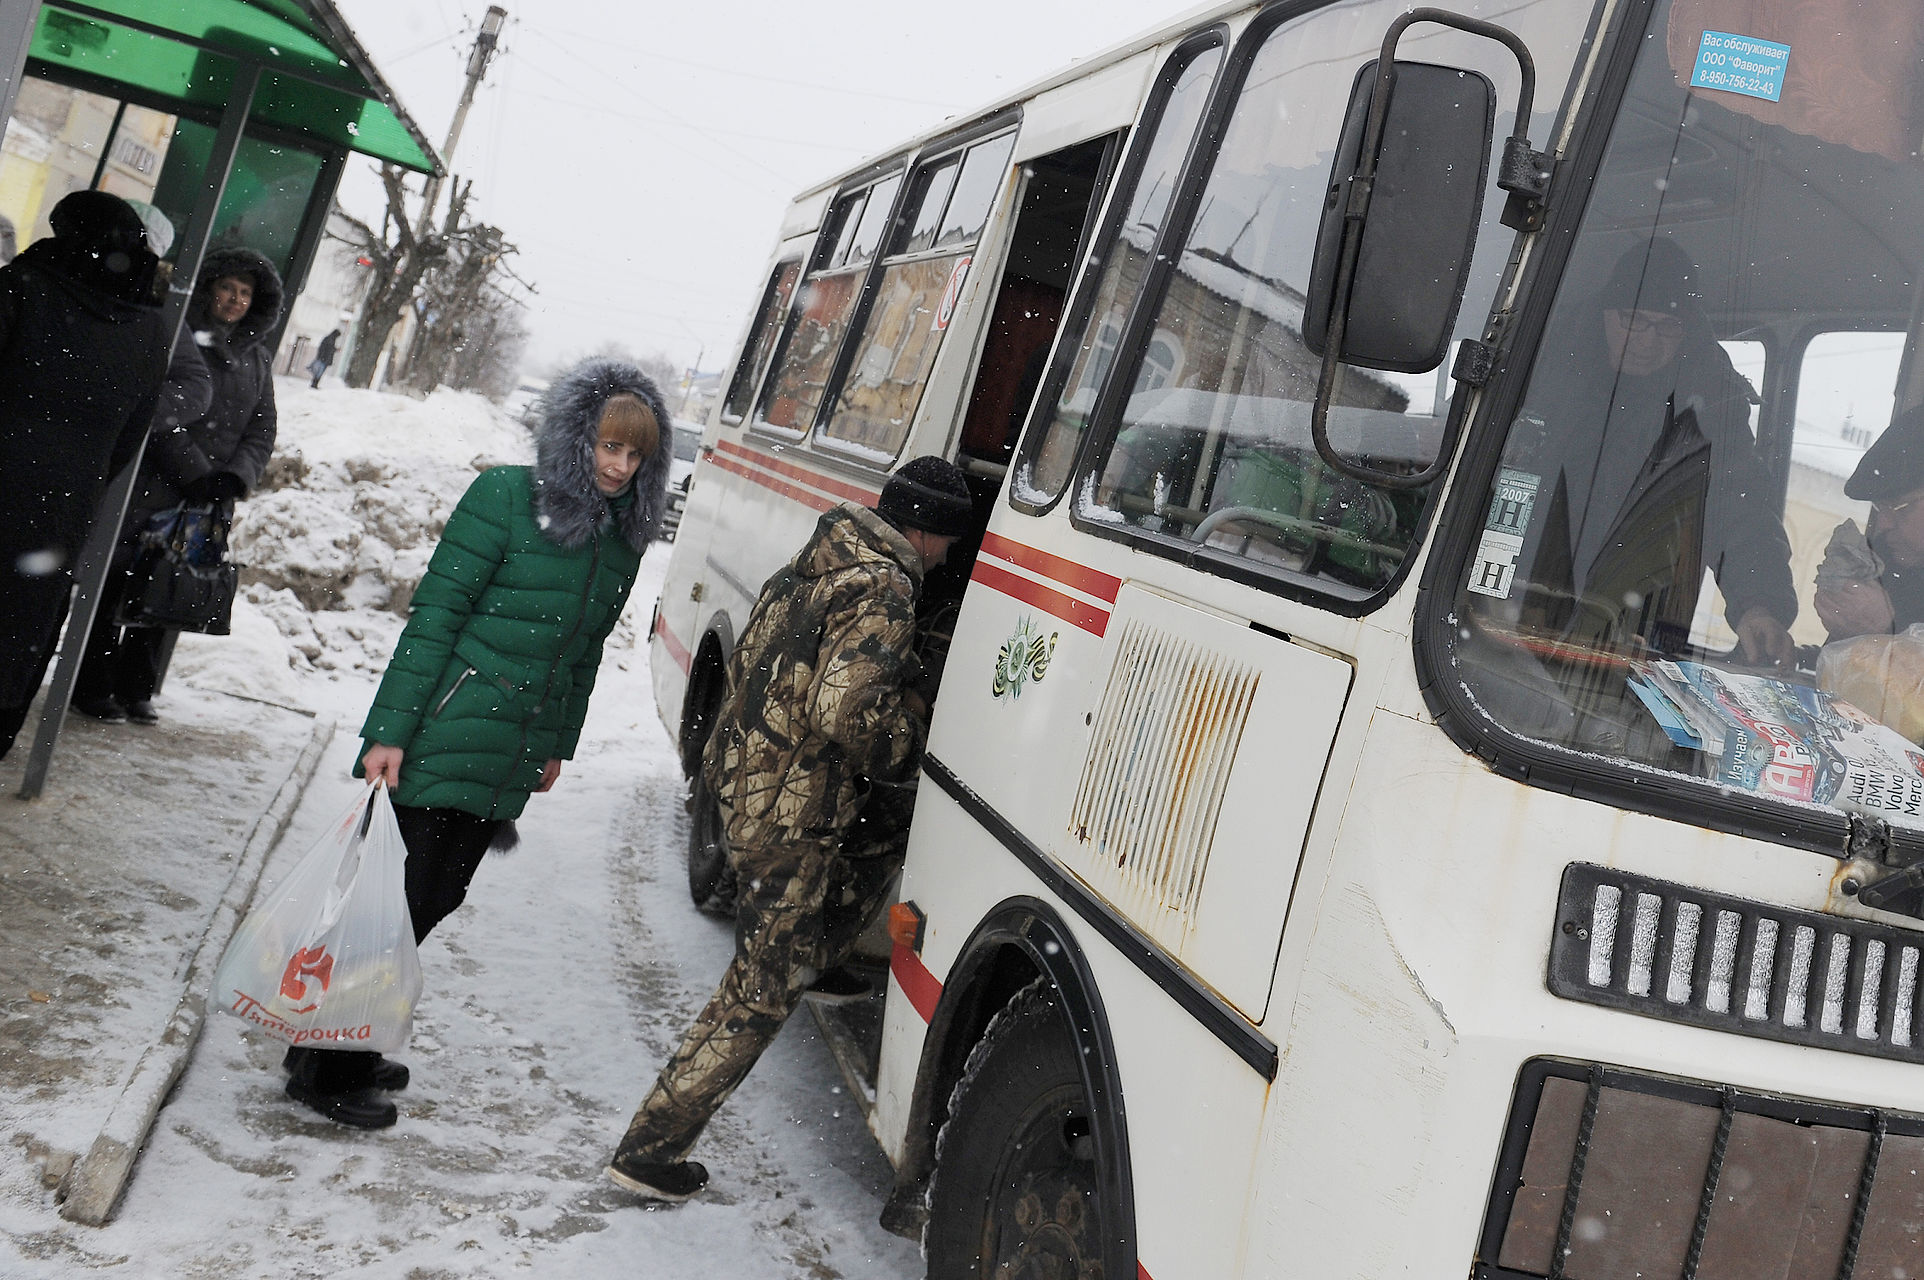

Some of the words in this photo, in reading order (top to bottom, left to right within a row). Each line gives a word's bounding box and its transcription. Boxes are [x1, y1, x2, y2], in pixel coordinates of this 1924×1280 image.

[1702, 51, 1726, 66] ООО
[1703, 33, 1722, 47] Вас
[1723, 37, 1788, 60] обслуживает
[1700, 69, 1775, 95] 8-950-756-22-43
[1500, 487, 1530, 504] 2007
[1846, 772, 1866, 805] Audi
[1865, 769, 1885, 808] BMW
[1884, 774, 1904, 810] Volvo
